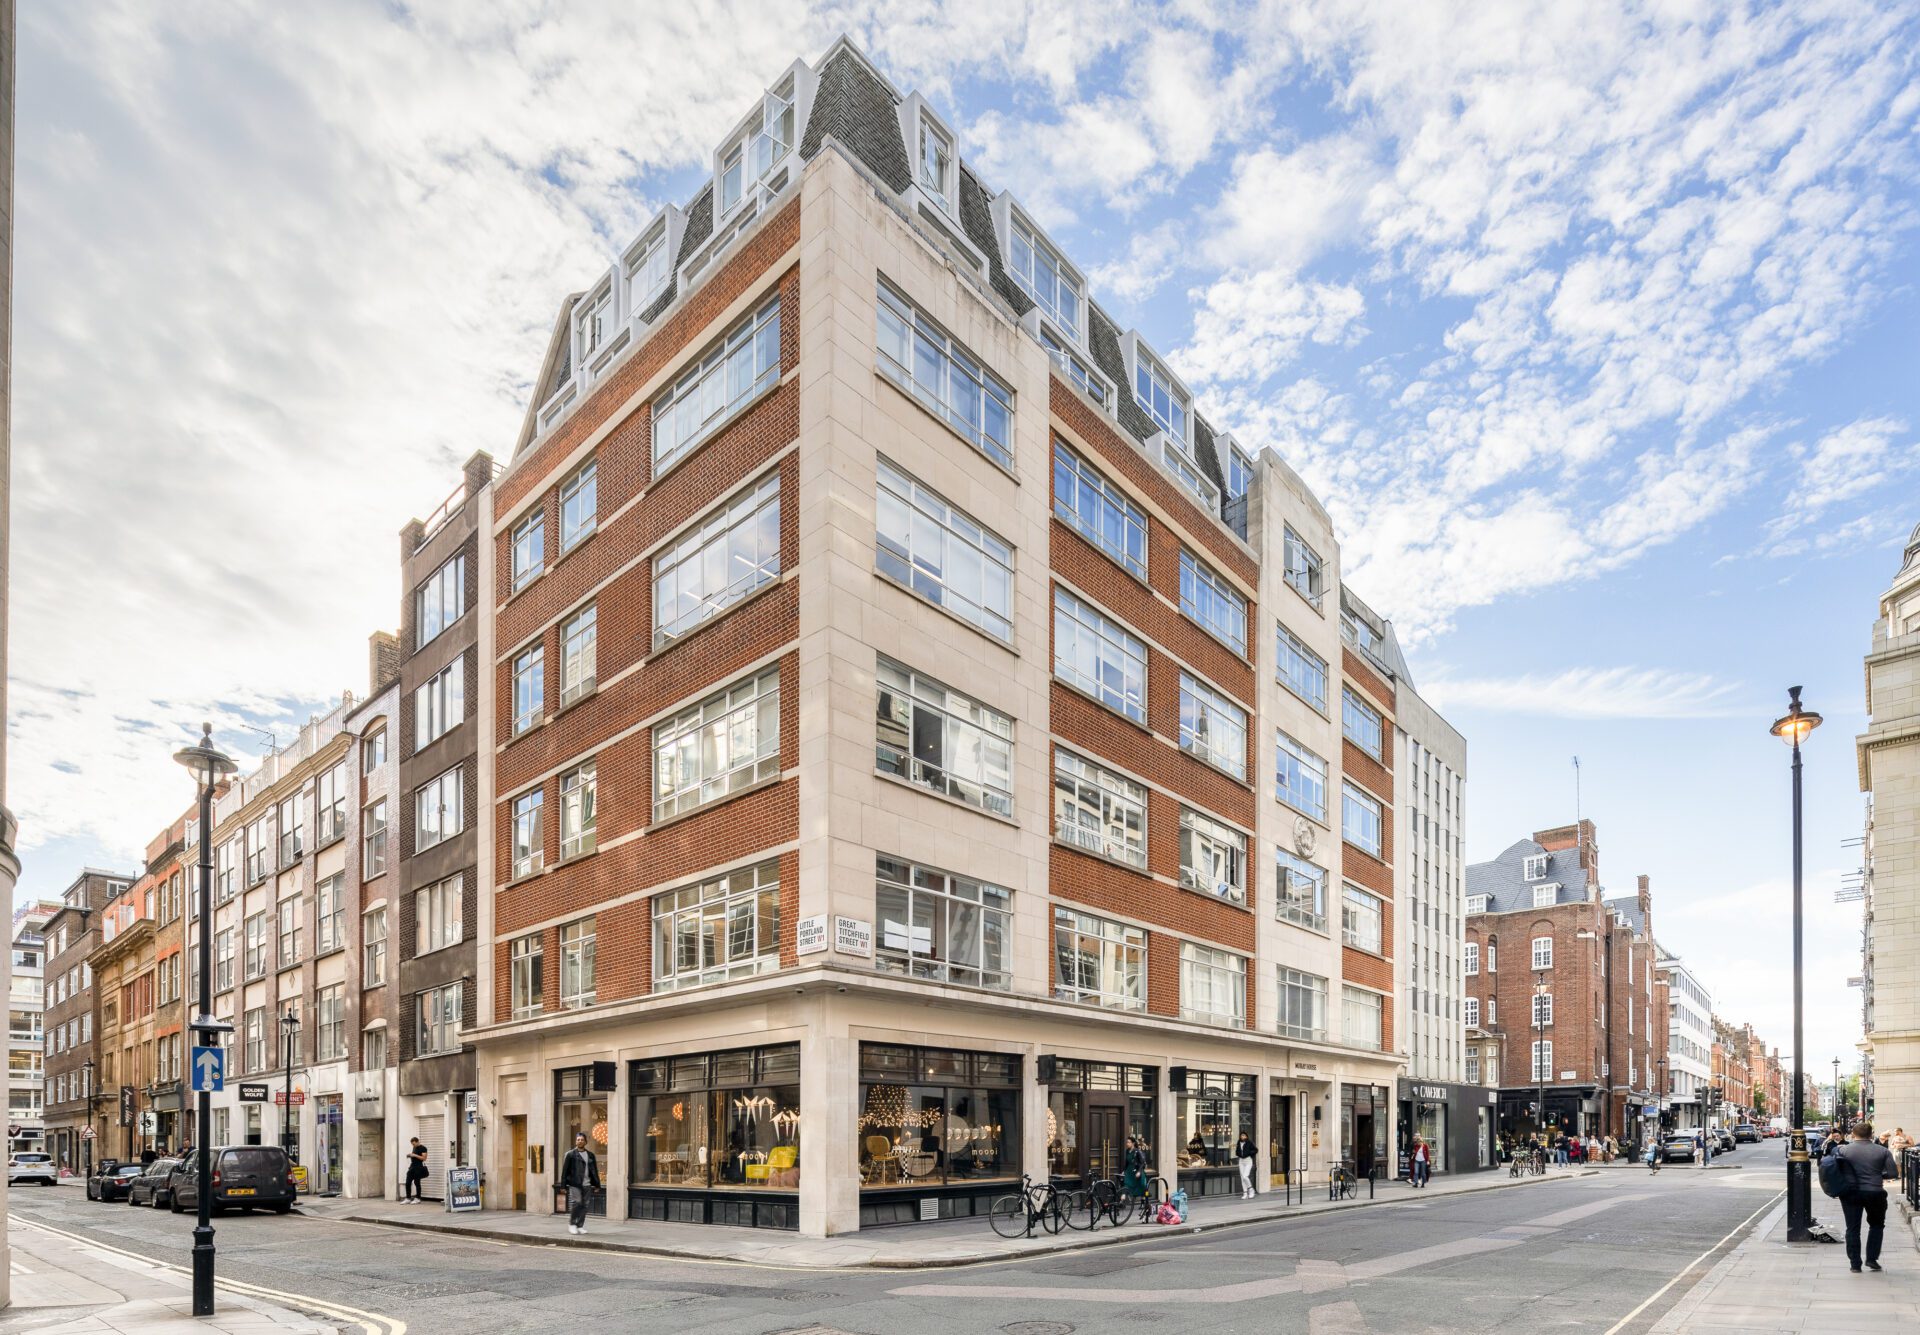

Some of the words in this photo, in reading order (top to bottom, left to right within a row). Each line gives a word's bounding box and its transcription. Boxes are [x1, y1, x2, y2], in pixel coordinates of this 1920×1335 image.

[800, 920, 815, 930] LITTLE
[838, 920, 857, 930] GREAT
[799, 926, 824, 936] PORTLAND
[839, 928, 870, 941] TITCHFIELD
[799, 936, 816, 947] STREET
[817, 934, 825, 943] W1
[838, 936, 859, 947] STREET
[860, 940, 868, 949] W1
